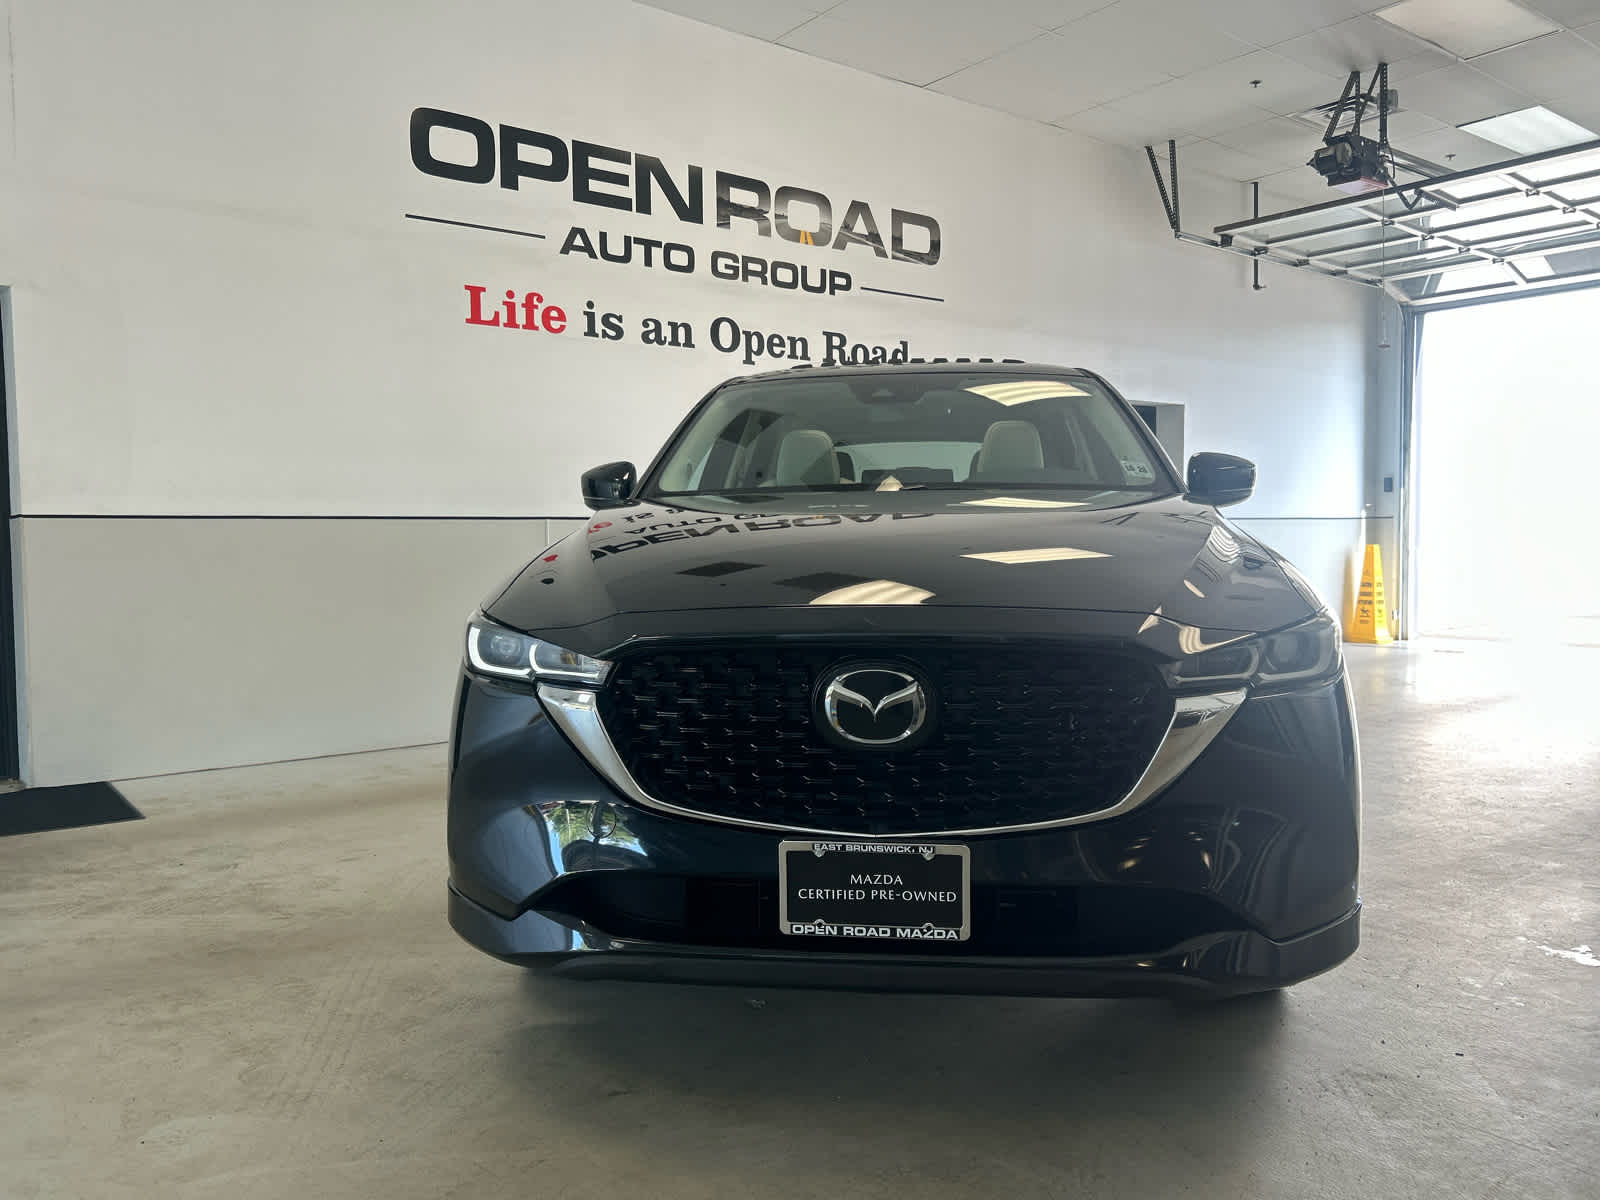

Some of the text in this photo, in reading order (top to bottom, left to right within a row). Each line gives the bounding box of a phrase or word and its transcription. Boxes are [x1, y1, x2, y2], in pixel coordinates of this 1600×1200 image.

[410, 107, 941, 265] OPEN ROAD
[560, 226, 852, 296] AUTO GROUP
[464, 284, 567, 334] Life
[583, 300, 624, 341] is
[641, 317, 695, 348] an
[710, 317, 811, 365] Open
[814, 843, 842, 851] EAST
[919, 846, 934, 854] NJ
[850, 874, 903, 885] MAZDA
[798, 888, 957, 902] CERTIFIED PRE-OWNED
[792, 924, 958, 939] OPEN ROAD MAZDA
